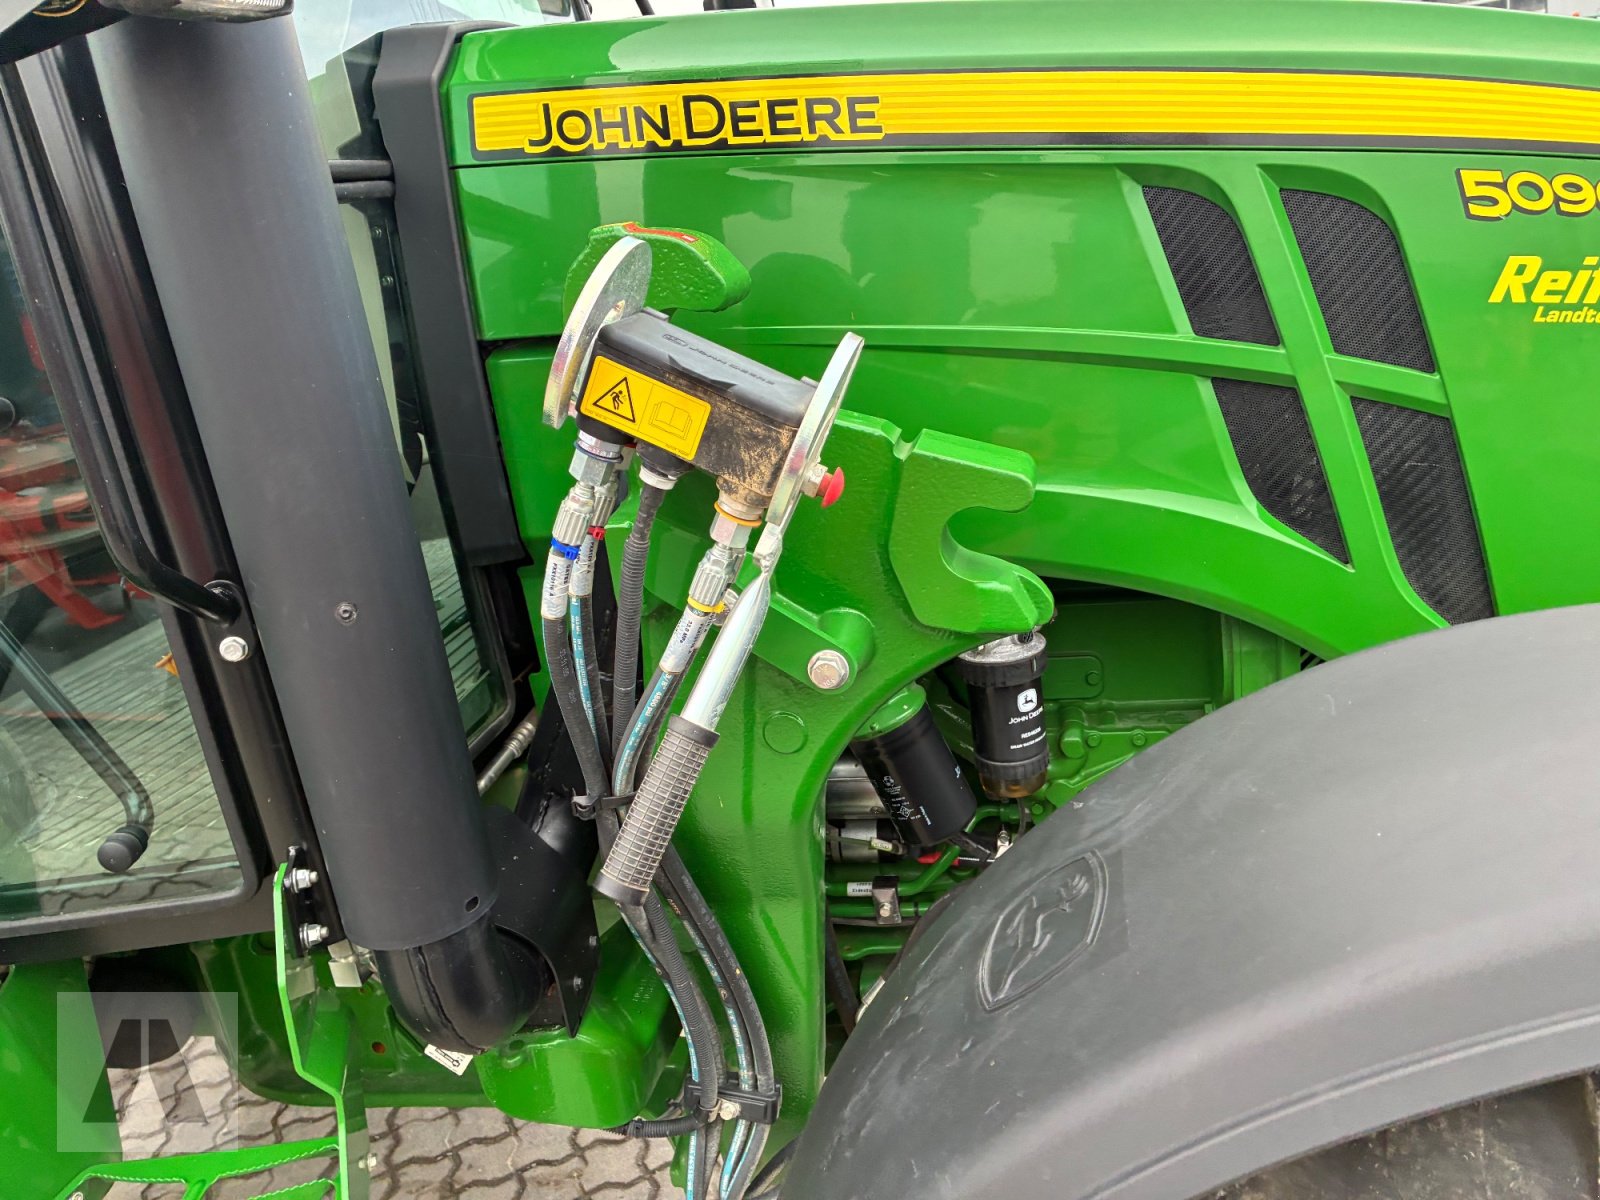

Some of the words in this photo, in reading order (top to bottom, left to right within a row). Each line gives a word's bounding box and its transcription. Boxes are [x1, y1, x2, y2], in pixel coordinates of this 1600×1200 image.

[526, 102, 671, 149] JOHN
[681, 93, 885, 142] DEERE
[1456, 168, 1600, 221] 509
[1008, 715, 1029, 725] JOHN
